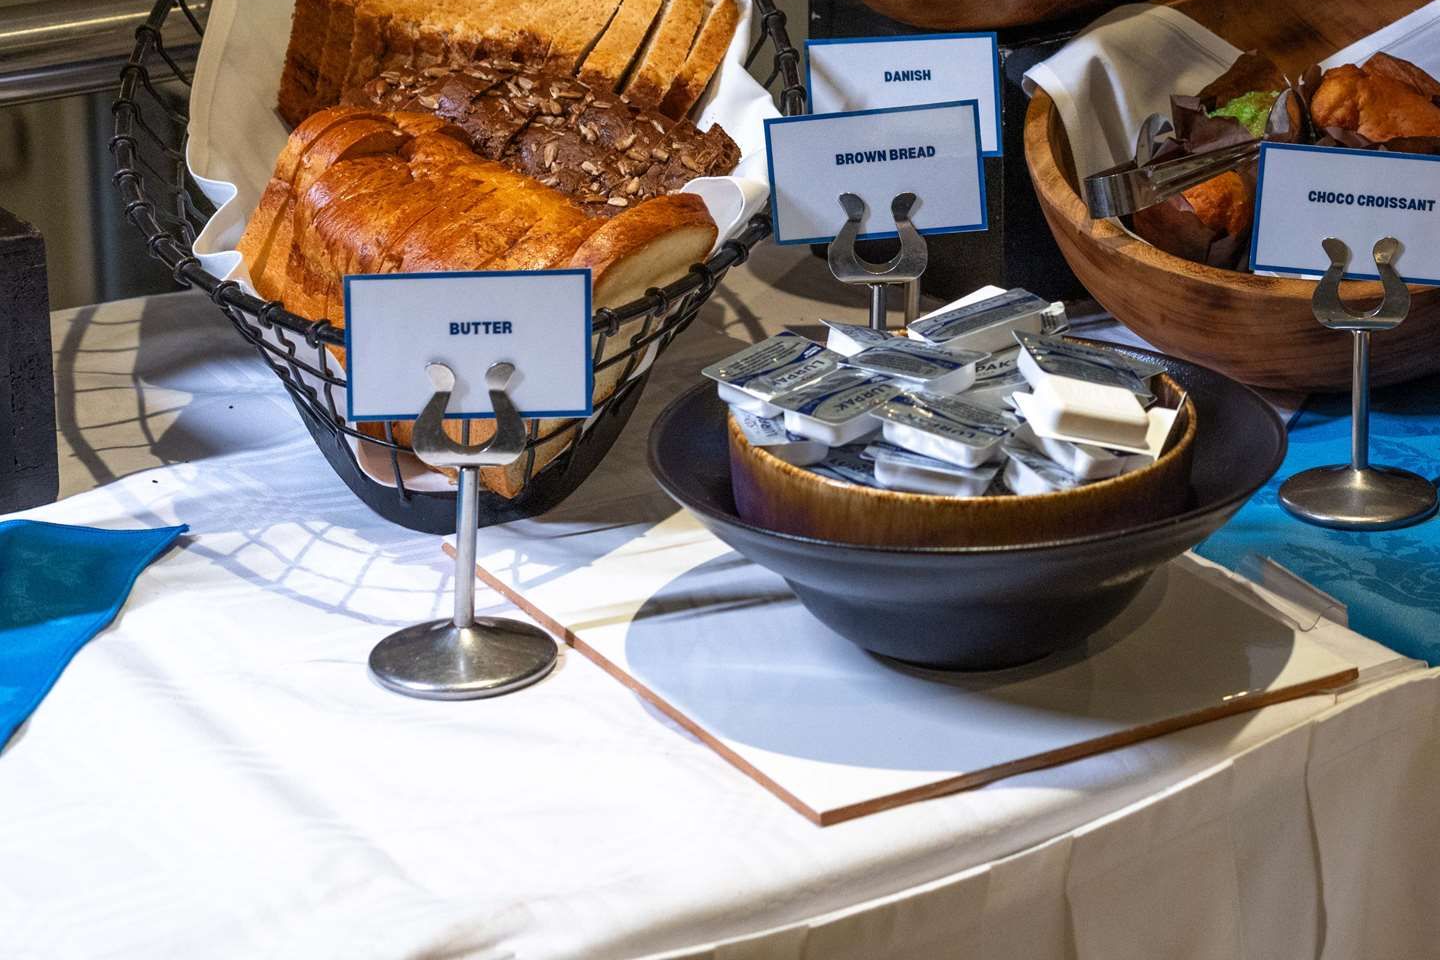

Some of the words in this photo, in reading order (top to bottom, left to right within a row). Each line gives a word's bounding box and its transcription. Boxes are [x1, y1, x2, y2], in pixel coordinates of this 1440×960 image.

[884, 69, 932, 83] DANISH
[836, 150, 887, 166] BROWN
[888, 146, 936, 161] BREAD
[1307, 190, 1355, 206] CHOCO
[1356, 194, 1437, 212] CROISSANT
[449, 320, 513, 336] BUTTER
[833, 383, 893, 411] LURPAK
